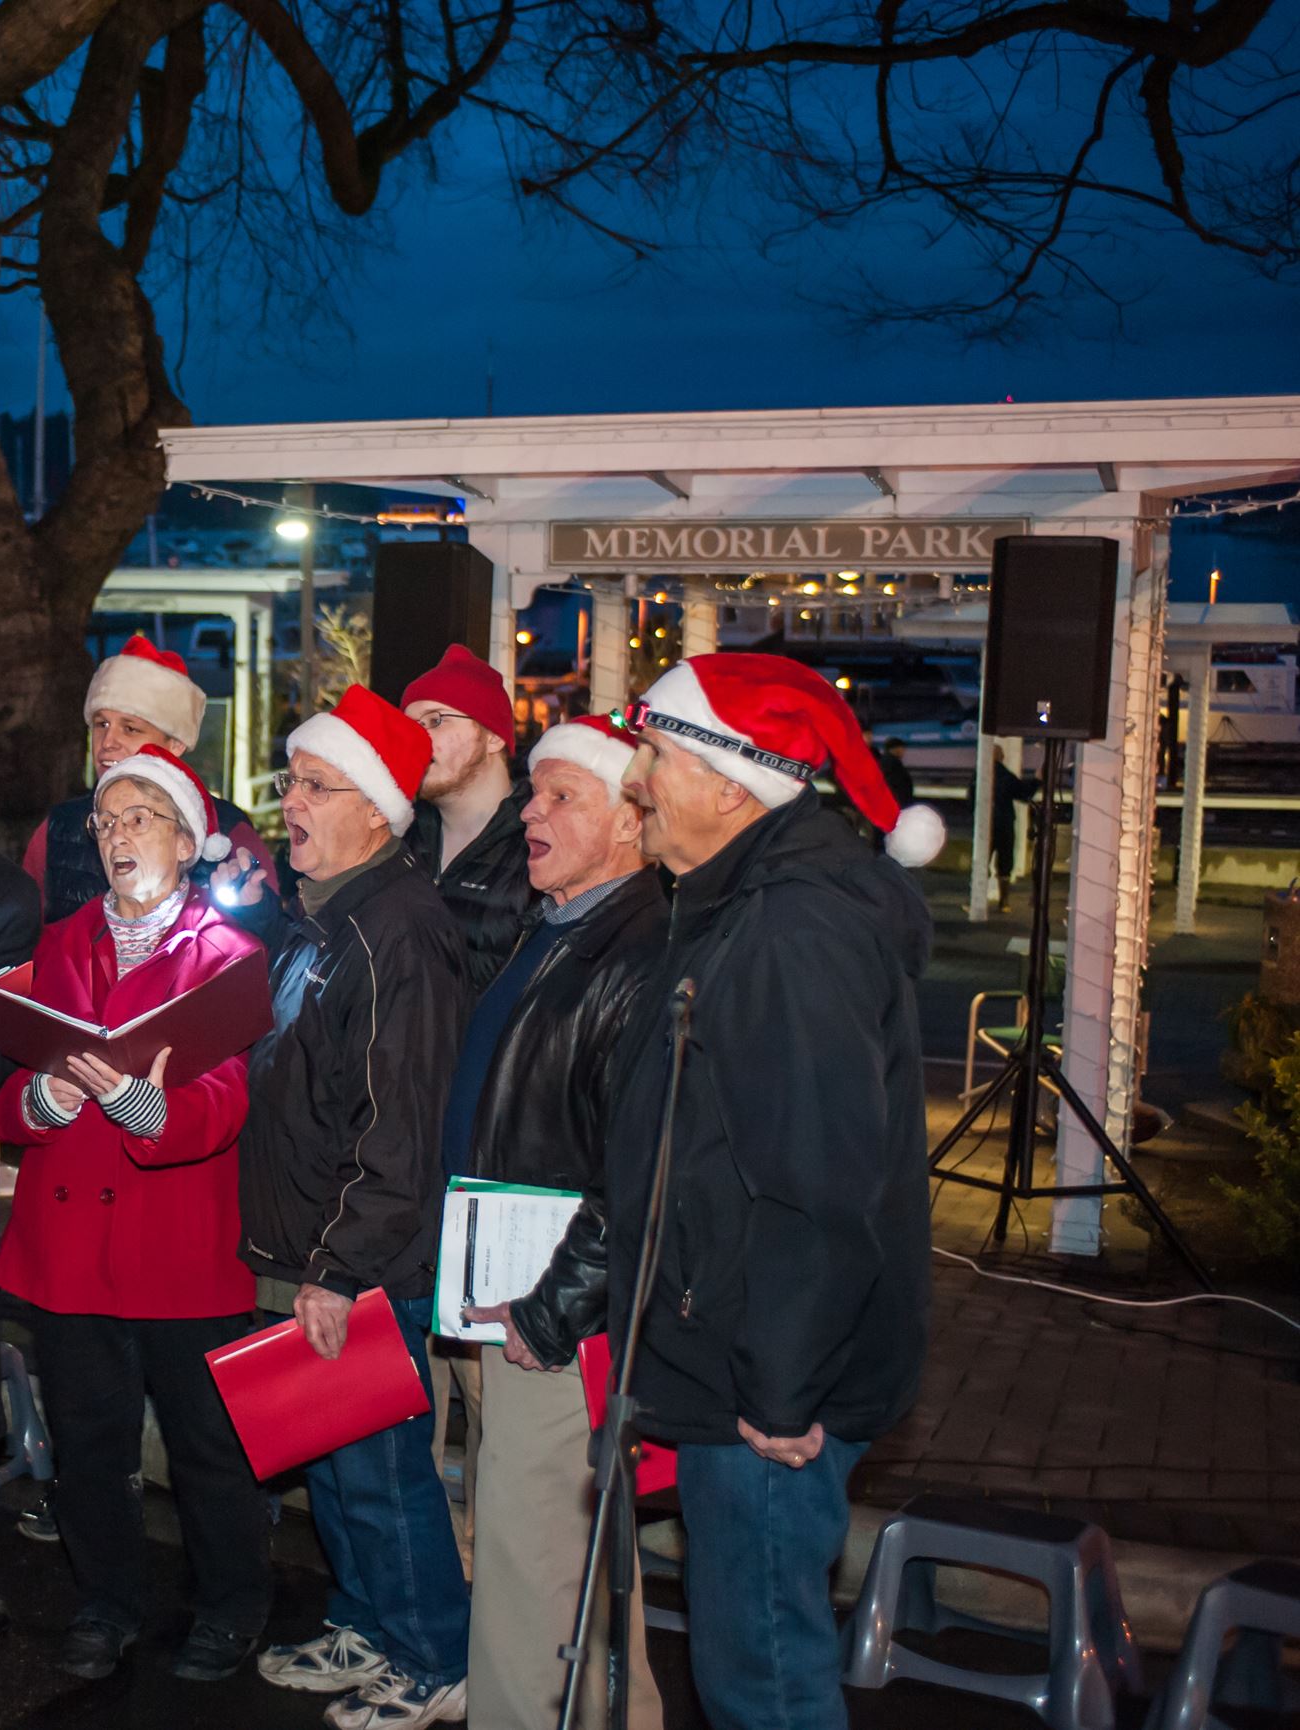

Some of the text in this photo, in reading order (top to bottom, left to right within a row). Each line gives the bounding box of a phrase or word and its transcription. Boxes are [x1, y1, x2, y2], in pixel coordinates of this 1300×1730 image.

[583, 525, 993, 559] MEMORIAL PARK
[646, 714, 678, 730] LED
[753, 751, 778, 767] LED
